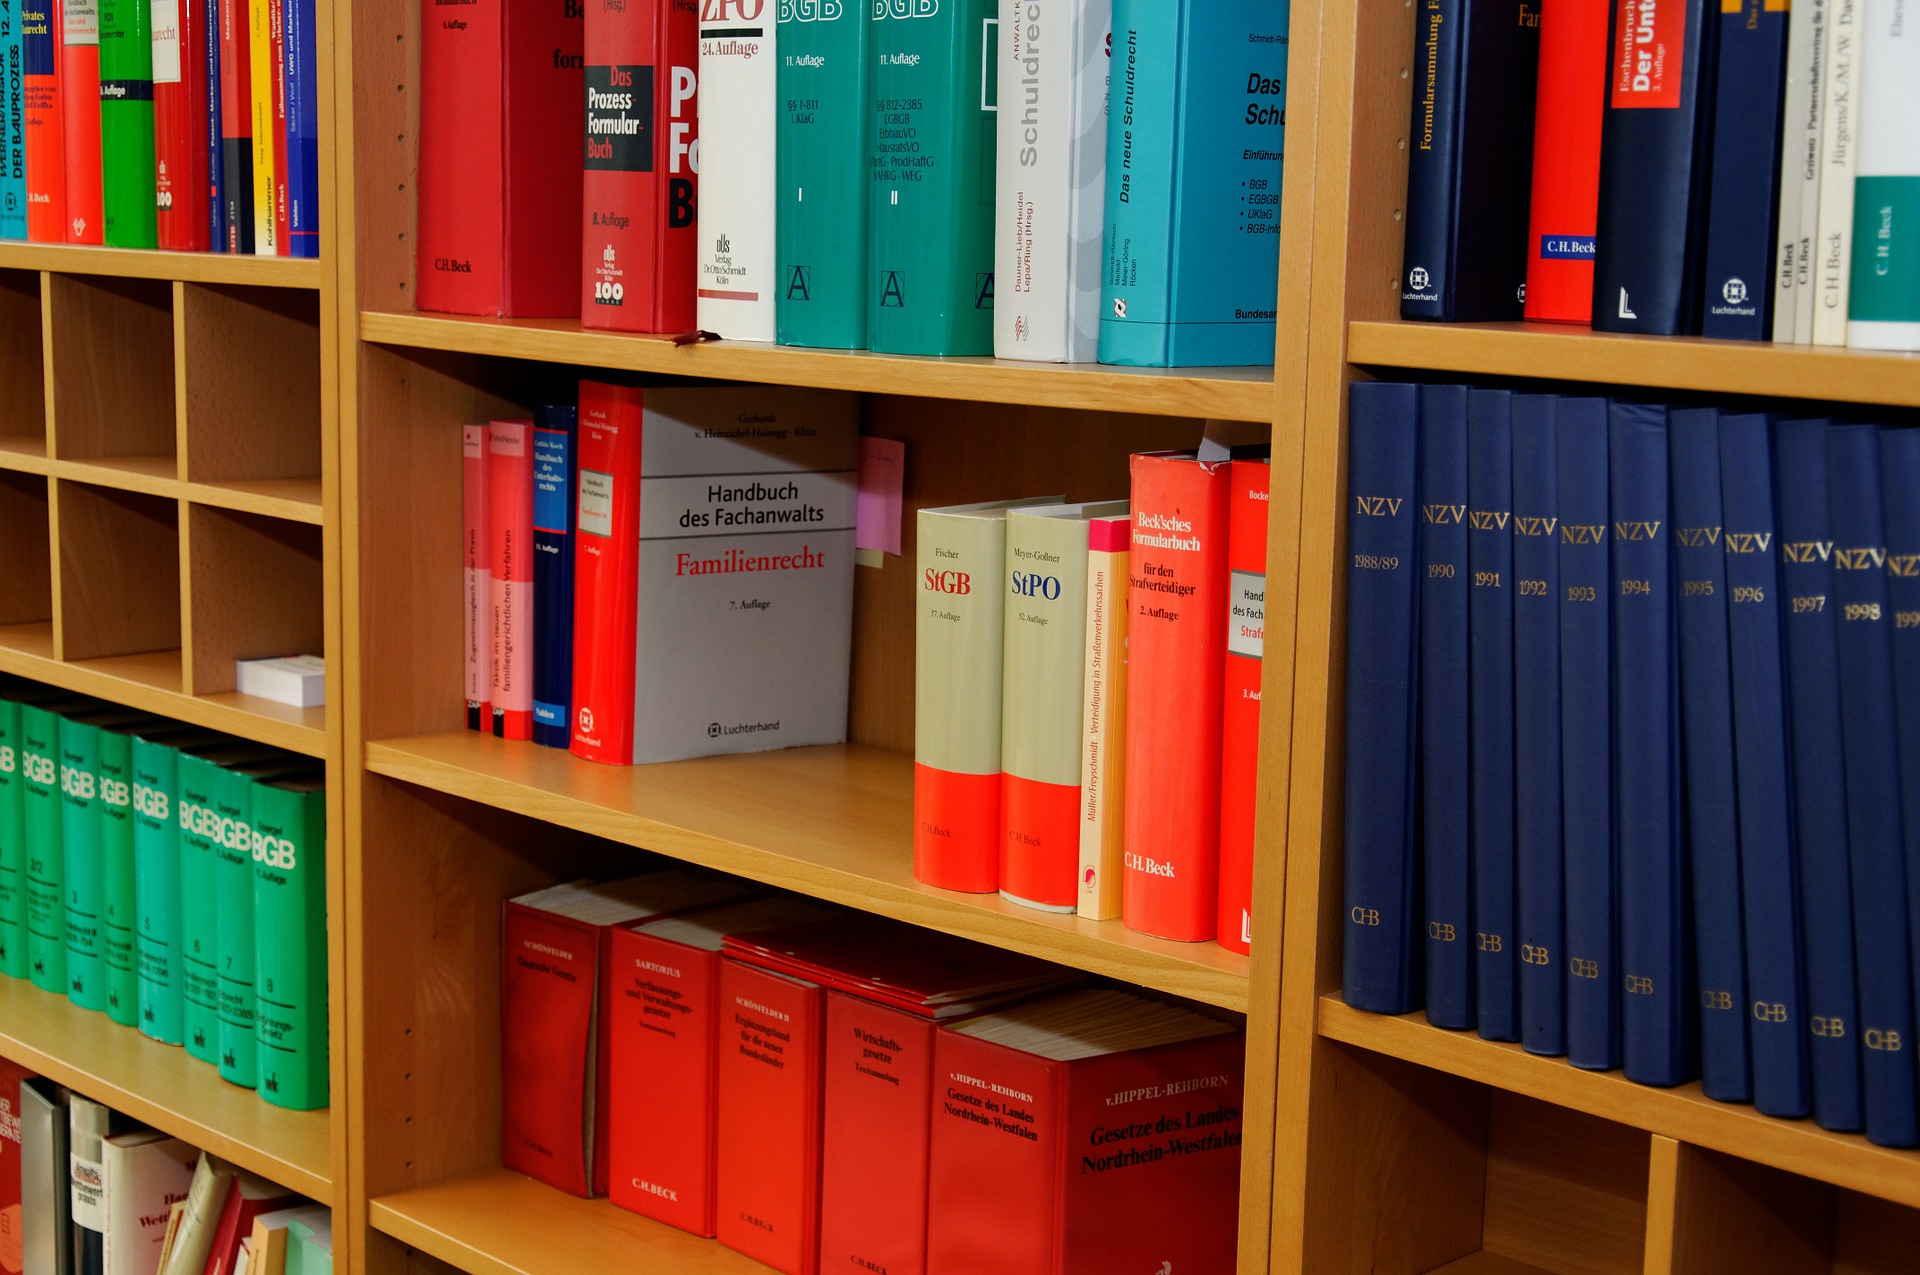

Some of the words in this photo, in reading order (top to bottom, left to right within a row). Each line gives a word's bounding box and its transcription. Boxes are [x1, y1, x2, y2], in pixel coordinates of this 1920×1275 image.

[701, 0, 764, 22] ZPO
[777, 0, 842, 23] BGB
[872, 0, 939, 20] BGB
[1620, 1, 1635, 92] Eschenbruch
[795, 54, 825, 68] Auflage
[889, 53, 920, 67] Auflage
[1654, 43, 1666, 82] Auflage
[611, 65, 633, 87] Das
[1124, 29, 1137, 125] Schuldrecht
[1633, 50, 1652, 92] Der
[1807, 27, 1823, 130] Partnerschaftsvertrag
[1246, 73, 1281, 95] Das
[1420, 14, 1442, 151] Formularsammlung
[10, 45, 21, 144] BAUPROZESS
[886, 98, 923, 110] 812-2385
[884, 113, 910, 125] EGBGB
[879, 127, 917, 139] ErbbauVO
[587, 137, 613, 159] Buch
[876, 141, 920, 153] HausratsVO
[1123, 130, 1132, 166] neue
[13, 149, 22, 178] DER
[890, 155, 934, 168] ProdHaftG
[901, 170, 923, 181] WEG
[1249, 179, 1267, 190] BGB
[1119, 173, 1130, 203] Das
[1248, 194, 1278, 205] EGBGB
[602, 212, 630, 230] Auflage
[1025, 202, 1033, 236] (Hrsg.)
[1247, 209, 1273, 220] UKlaG
[1015, 192, 1023, 293] Dauner-Lieb/Heidel
[715, 254, 732, 265] Verlag
[1023, 239, 1032, 293] Lepa/Ring
[1121, 238, 1130, 286] Meier-Göring
[1782, 243, 1794, 289] C.H.Beck
[1798, 237, 1810, 285] C.H.Beck
[716, 275, 729, 285] Köln
[1129, 259, 1137, 286] Röcken
[595, 282, 623, 300] 100
[1402, 291, 1438, 301] Luchterhand
[1712, 305, 1755, 316] Luchterhand
[738, 413, 776, 423] Gerhardt
[794, 427, 816, 437] Klein
[708, 482, 798, 503] Handbuch
[679, 509, 710, 528] des
[715, 504, 824, 526] Fachanwalts
[1357, 496, 1403, 517] NZV
[1422, 504, 1467, 524] NZV
[1138, 512, 1191, 533] Beck'sches
[1469, 511, 1510, 530] NZV
[1514, 517, 1558, 536] NZV
[1132, 530, 1200, 552] Formularbuch
[1561, 525, 1606, 545] NZV
[1615, 521, 1661, 541] NZV
[1676, 527, 1721, 547] NZV
[1725, 533, 1772, 553] NZV
[1783, 541, 1834, 563] NZV
[503, 530, 511, 581] Verfahren
[675, 545, 825, 577] Familienrecht
[935, 547, 959, 560] Fischer
[1014, 547, 1061, 563] Meyer-Goßner
[1354, 554, 1399, 570] 1988/89
[1835, 548, 1887, 570] NZV
[1143, 562, 1156, 576] für
[1157, 565, 1174, 578] den
[1428, 564, 1455, 578] 1990
[1475, 572, 1501, 587] 1991
[924, 567, 971, 595] StGB
[1012, 570, 1061, 601] StPO
[1130, 575, 1196, 598] Strafverteidiger
[1519, 580, 1547, 596] 1992
[1621, 580, 1651, 595] 1994
[1683, 580, 1714, 596] 1995
[1568, 587, 1596, 602] 1993
[1733, 587, 1764, 603] 1996
[1793, 596, 1826, 613] 1997
[739, 599, 771, 611] Auflage
[1140, 606, 1147, 616] 2.
[1148, 606, 1179, 622] Auflage
[1233, 604, 1245, 616] des
[1845, 603, 1881, 620] 1998
[1094, 571, 1104, 665] Straßenverkehrssachen
[503, 583, 513, 692] familiengerichtlichen
[1090, 680, 1101, 734] Verteidigung
[724, 720, 780, 735] Luchterhand
[1088, 741, 1098, 822] Müller/Freyschmidt
[921, 822, 952, 838] C.H.Beck
[1009, 830, 1041, 847] C.H.Beck
[1124, 851, 1175, 879] C.H.Beck
[635, 959, 681, 979] SARTORIUS
[625, 988, 641, 999] und
[853, 1028, 903, 1053] Wirtschafts-
[739, 1044, 784, 1069] Bundesländer
[863, 1046, 893, 1065] gesetze
[855, 1063, 900, 1086] Textsammlung
[947, 1087, 983, 1109] Gesetze
[985, 1098, 1000, 1113] des
[1002, 1103, 1035, 1125] Landes
[943, 1103, 1038, 1142] Nordrhein-Westfalen
[1090, 1122, 1153, 1147] Gesetze
[1155, 1114, 1182, 1135] des
[1185, 1104, 1239, 1130] Landes
[632, 1177, 678, 1202] C.H.BECK
